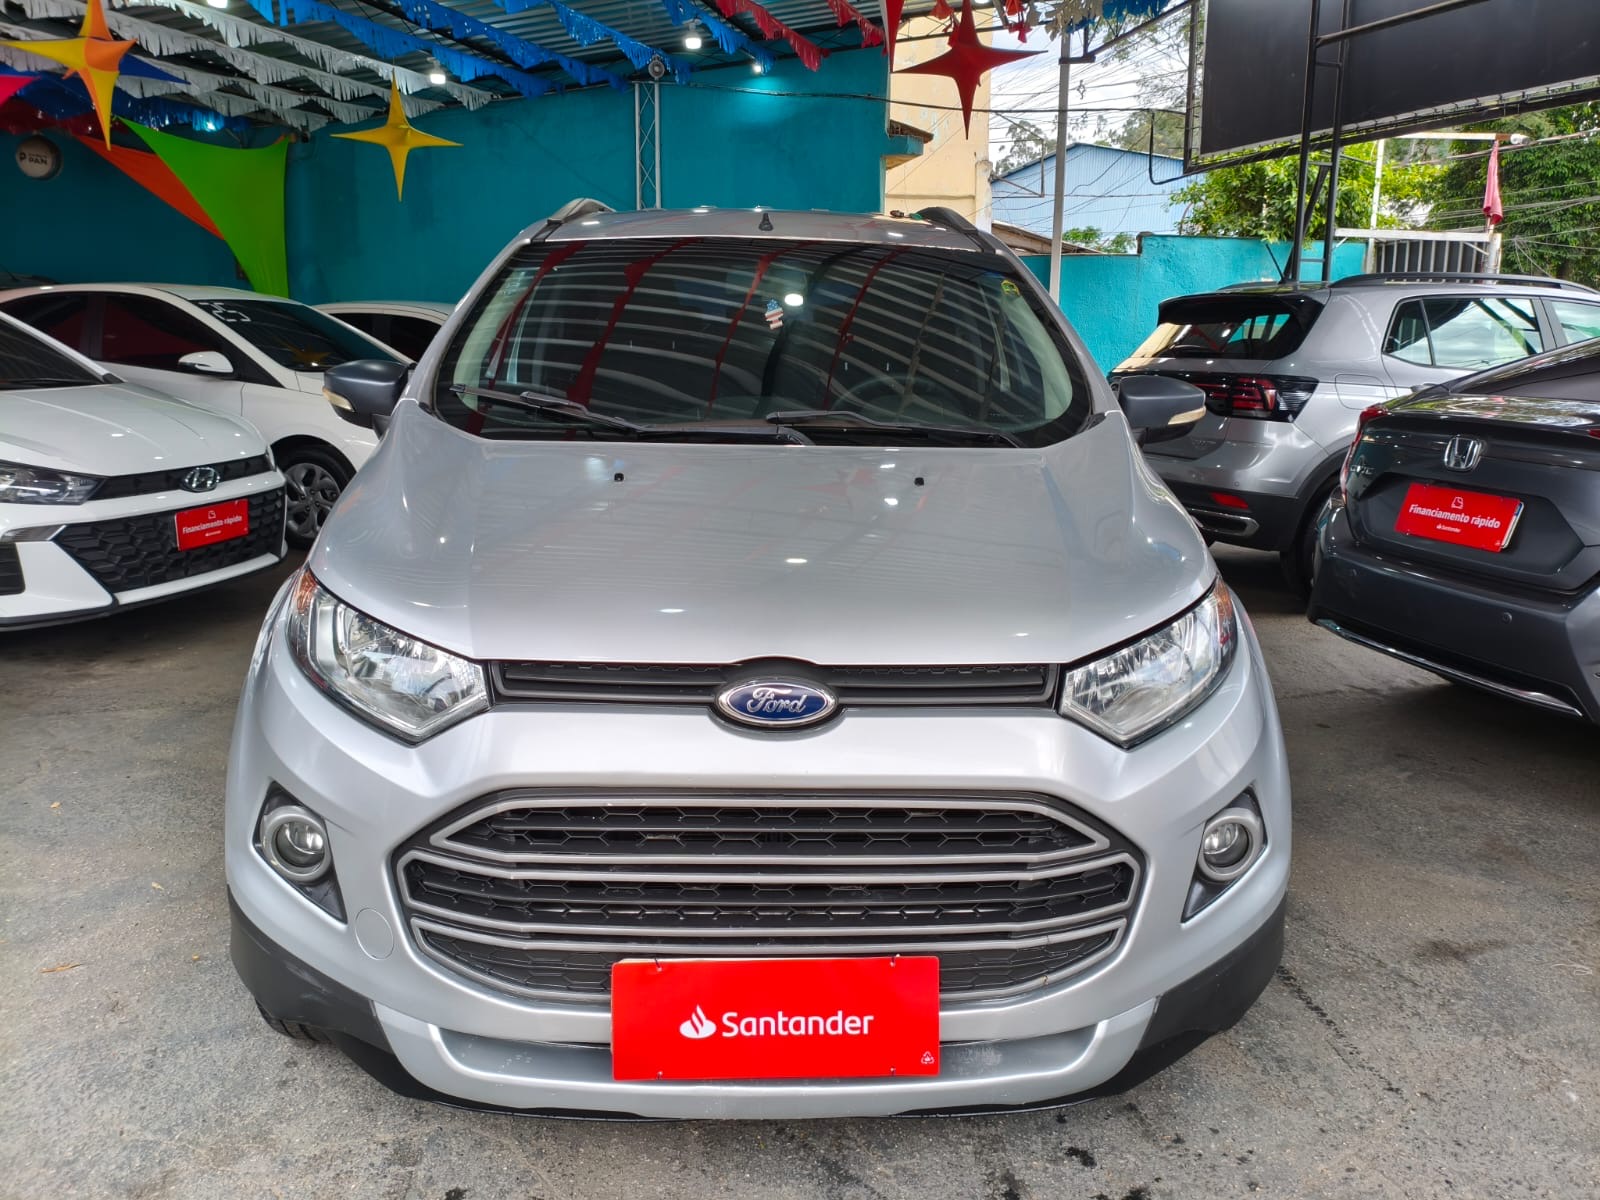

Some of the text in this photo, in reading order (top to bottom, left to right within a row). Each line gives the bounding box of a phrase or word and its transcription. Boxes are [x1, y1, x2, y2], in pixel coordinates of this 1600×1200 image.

[28, 157, 48, 165] PAN
[1408, 504, 1501, 529] Financiamento rápido
[746, 687, 807, 713] Ford
[721, 1010, 874, 1038] Santander
